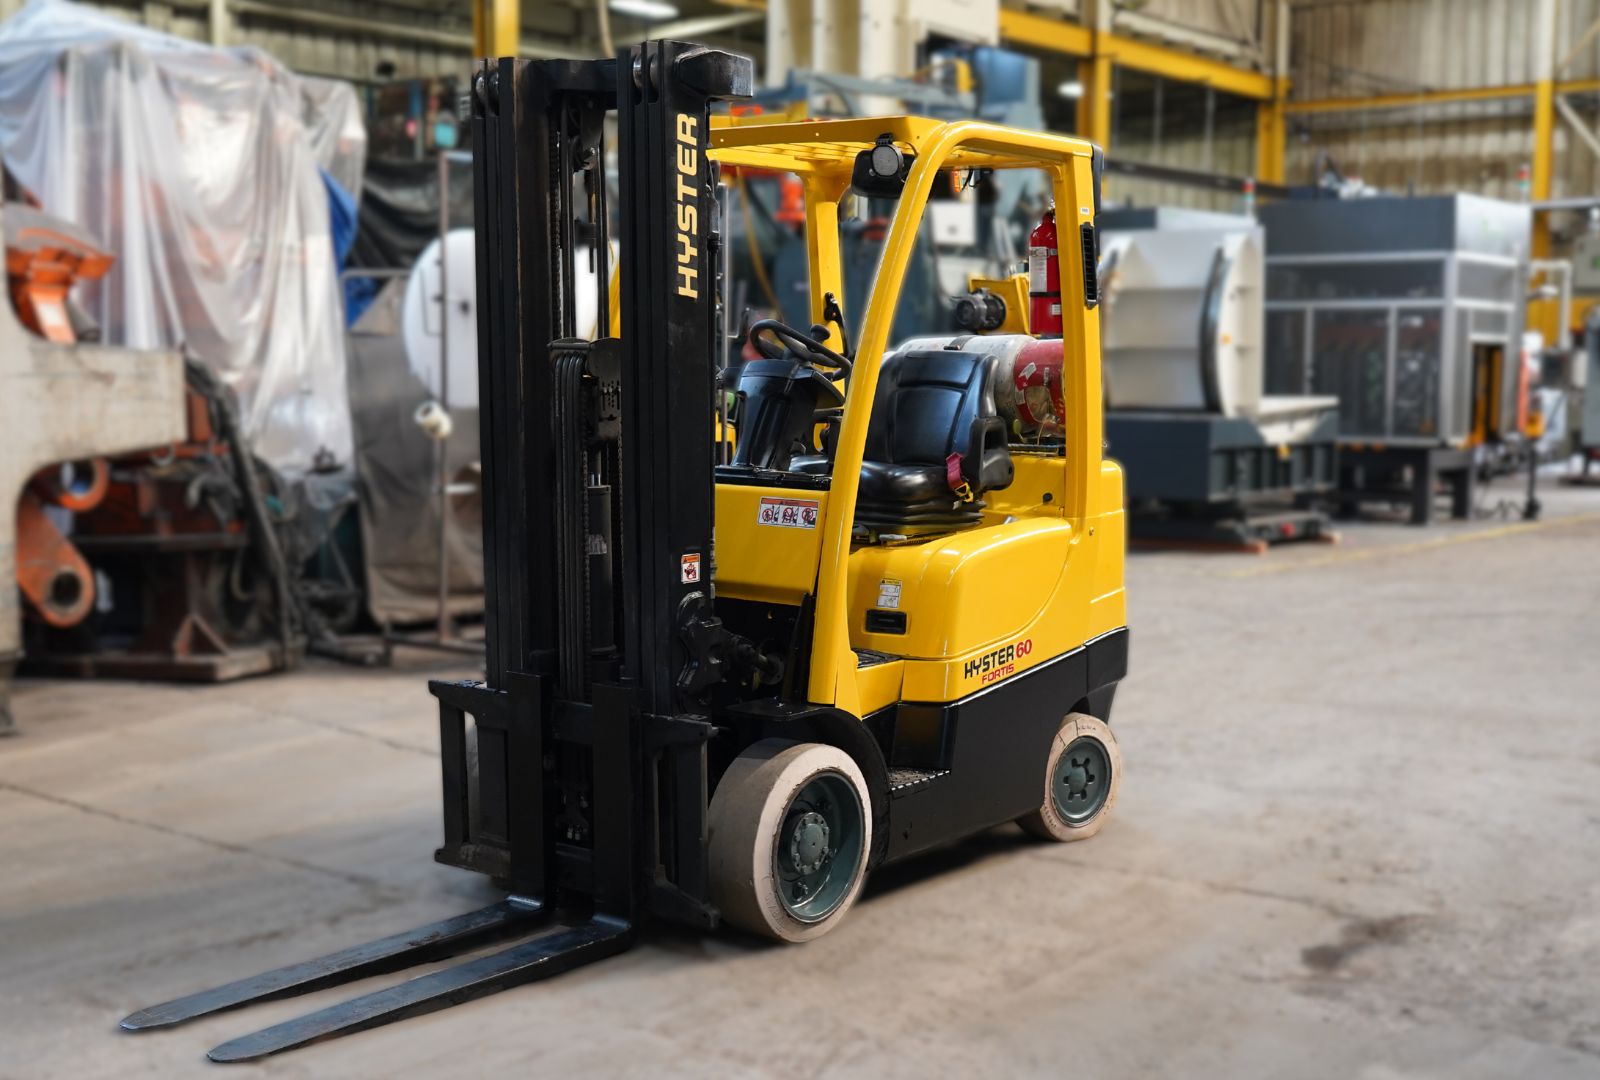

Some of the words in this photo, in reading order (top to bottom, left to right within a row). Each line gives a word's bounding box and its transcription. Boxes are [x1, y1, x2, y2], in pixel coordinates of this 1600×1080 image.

[677, 113, 698, 298] HYSTER
[965, 645, 1014, 679] HYSTER
[1016, 639, 1032, 658] 60
[982, 664, 1014, 684] FORTIS
